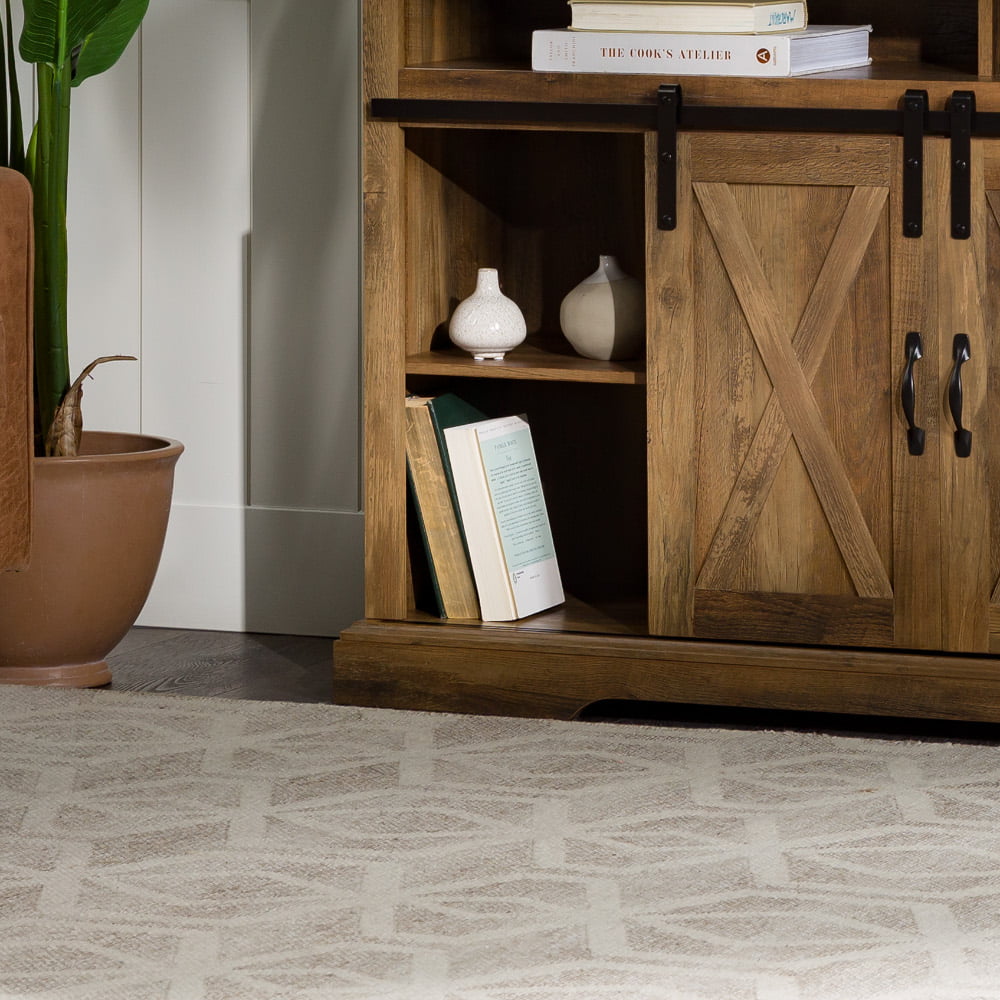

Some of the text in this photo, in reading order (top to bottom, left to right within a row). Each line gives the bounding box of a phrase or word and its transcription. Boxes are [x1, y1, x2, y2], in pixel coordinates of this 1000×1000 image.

[600, 47, 731, 60] THE COOK'S ATELIER
